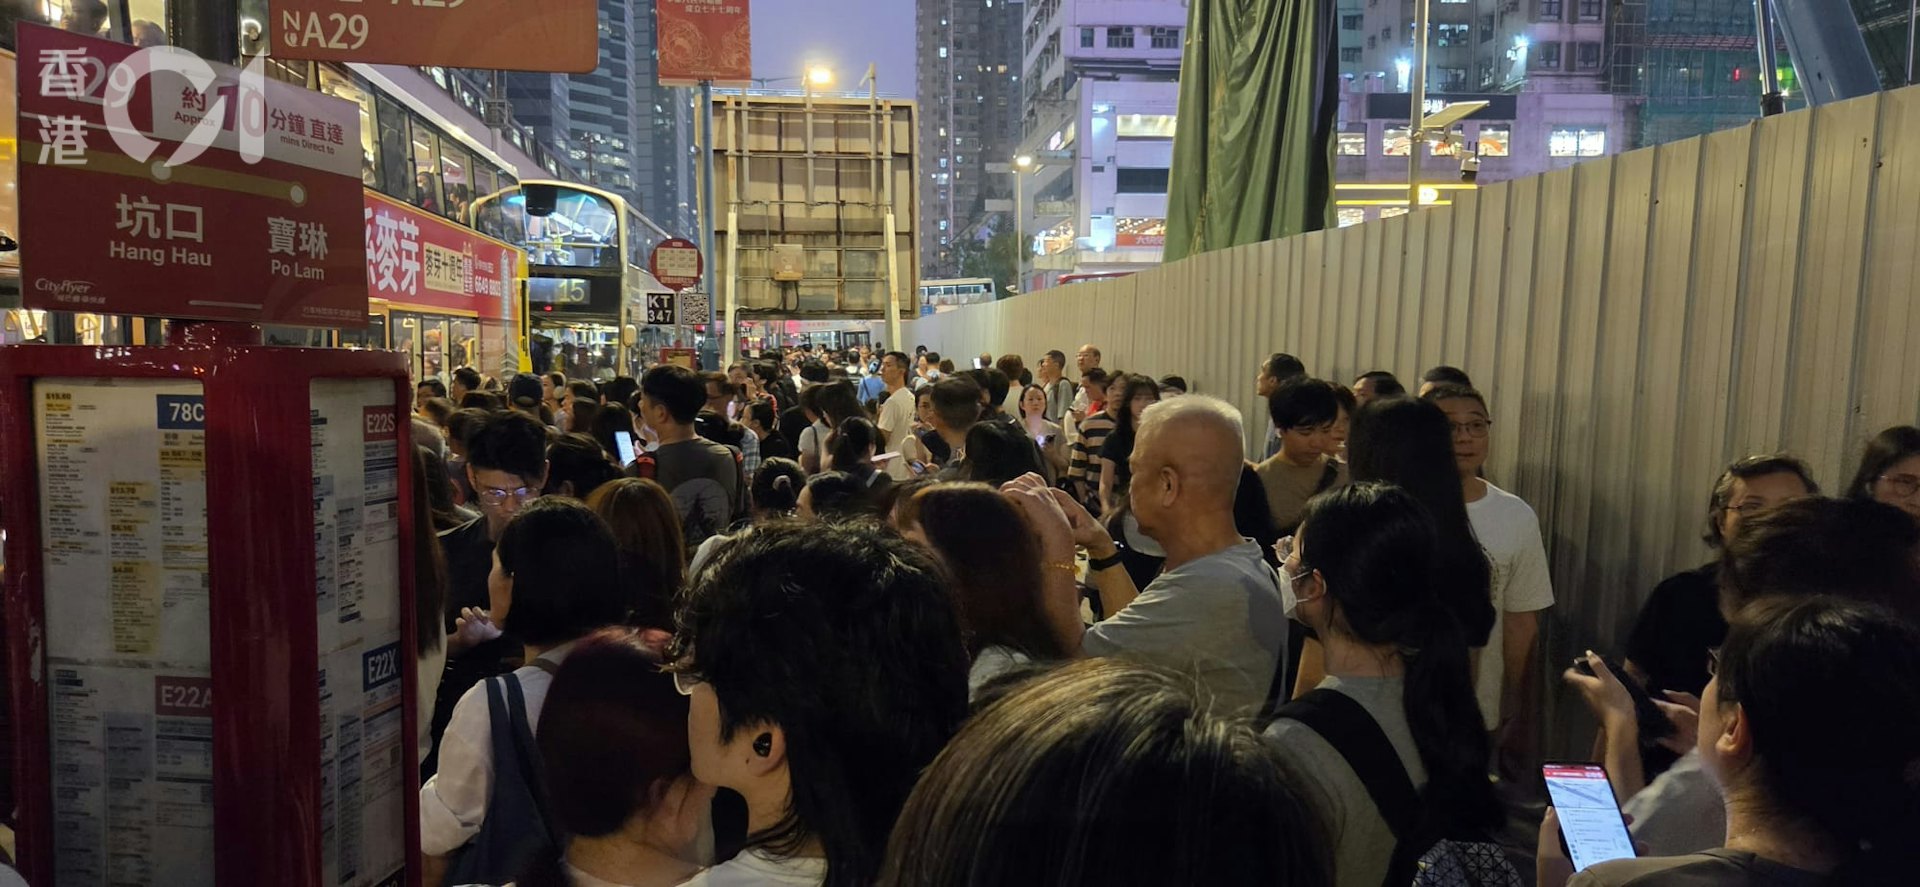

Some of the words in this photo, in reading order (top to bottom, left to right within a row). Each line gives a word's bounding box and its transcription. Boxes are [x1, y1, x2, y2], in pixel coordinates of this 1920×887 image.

[181, 87, 206, 112] 約
[270, 108, 306, 137] 分鐘
[310, 118, 344, 146] 直達
[280, 134, 301, 147] mins
[301, 138, 326, 153] Direct
[326, 144, 335, 155] to
[115, 193, 204, 243] 坑口
[267, 216, 328, 260] 寶琳
[110, 240, 165, 267] Hang
[171, 246, 212, 267] Hau
[364, 207, 421, 296] 麥芽
[271, 259, 290, 277] Po
[294, 262, 325, 281] Lam
[558, 279, 585, 302] 15
[648, 295, 671, 308] KT
[648, 310, 672, 323] 347
[169, 402, 205, 422] 78C
[366, 413, 396, 434] E22S
[368, 648, 397, 685] E22X
[161, 685, 212, 708] E22A
